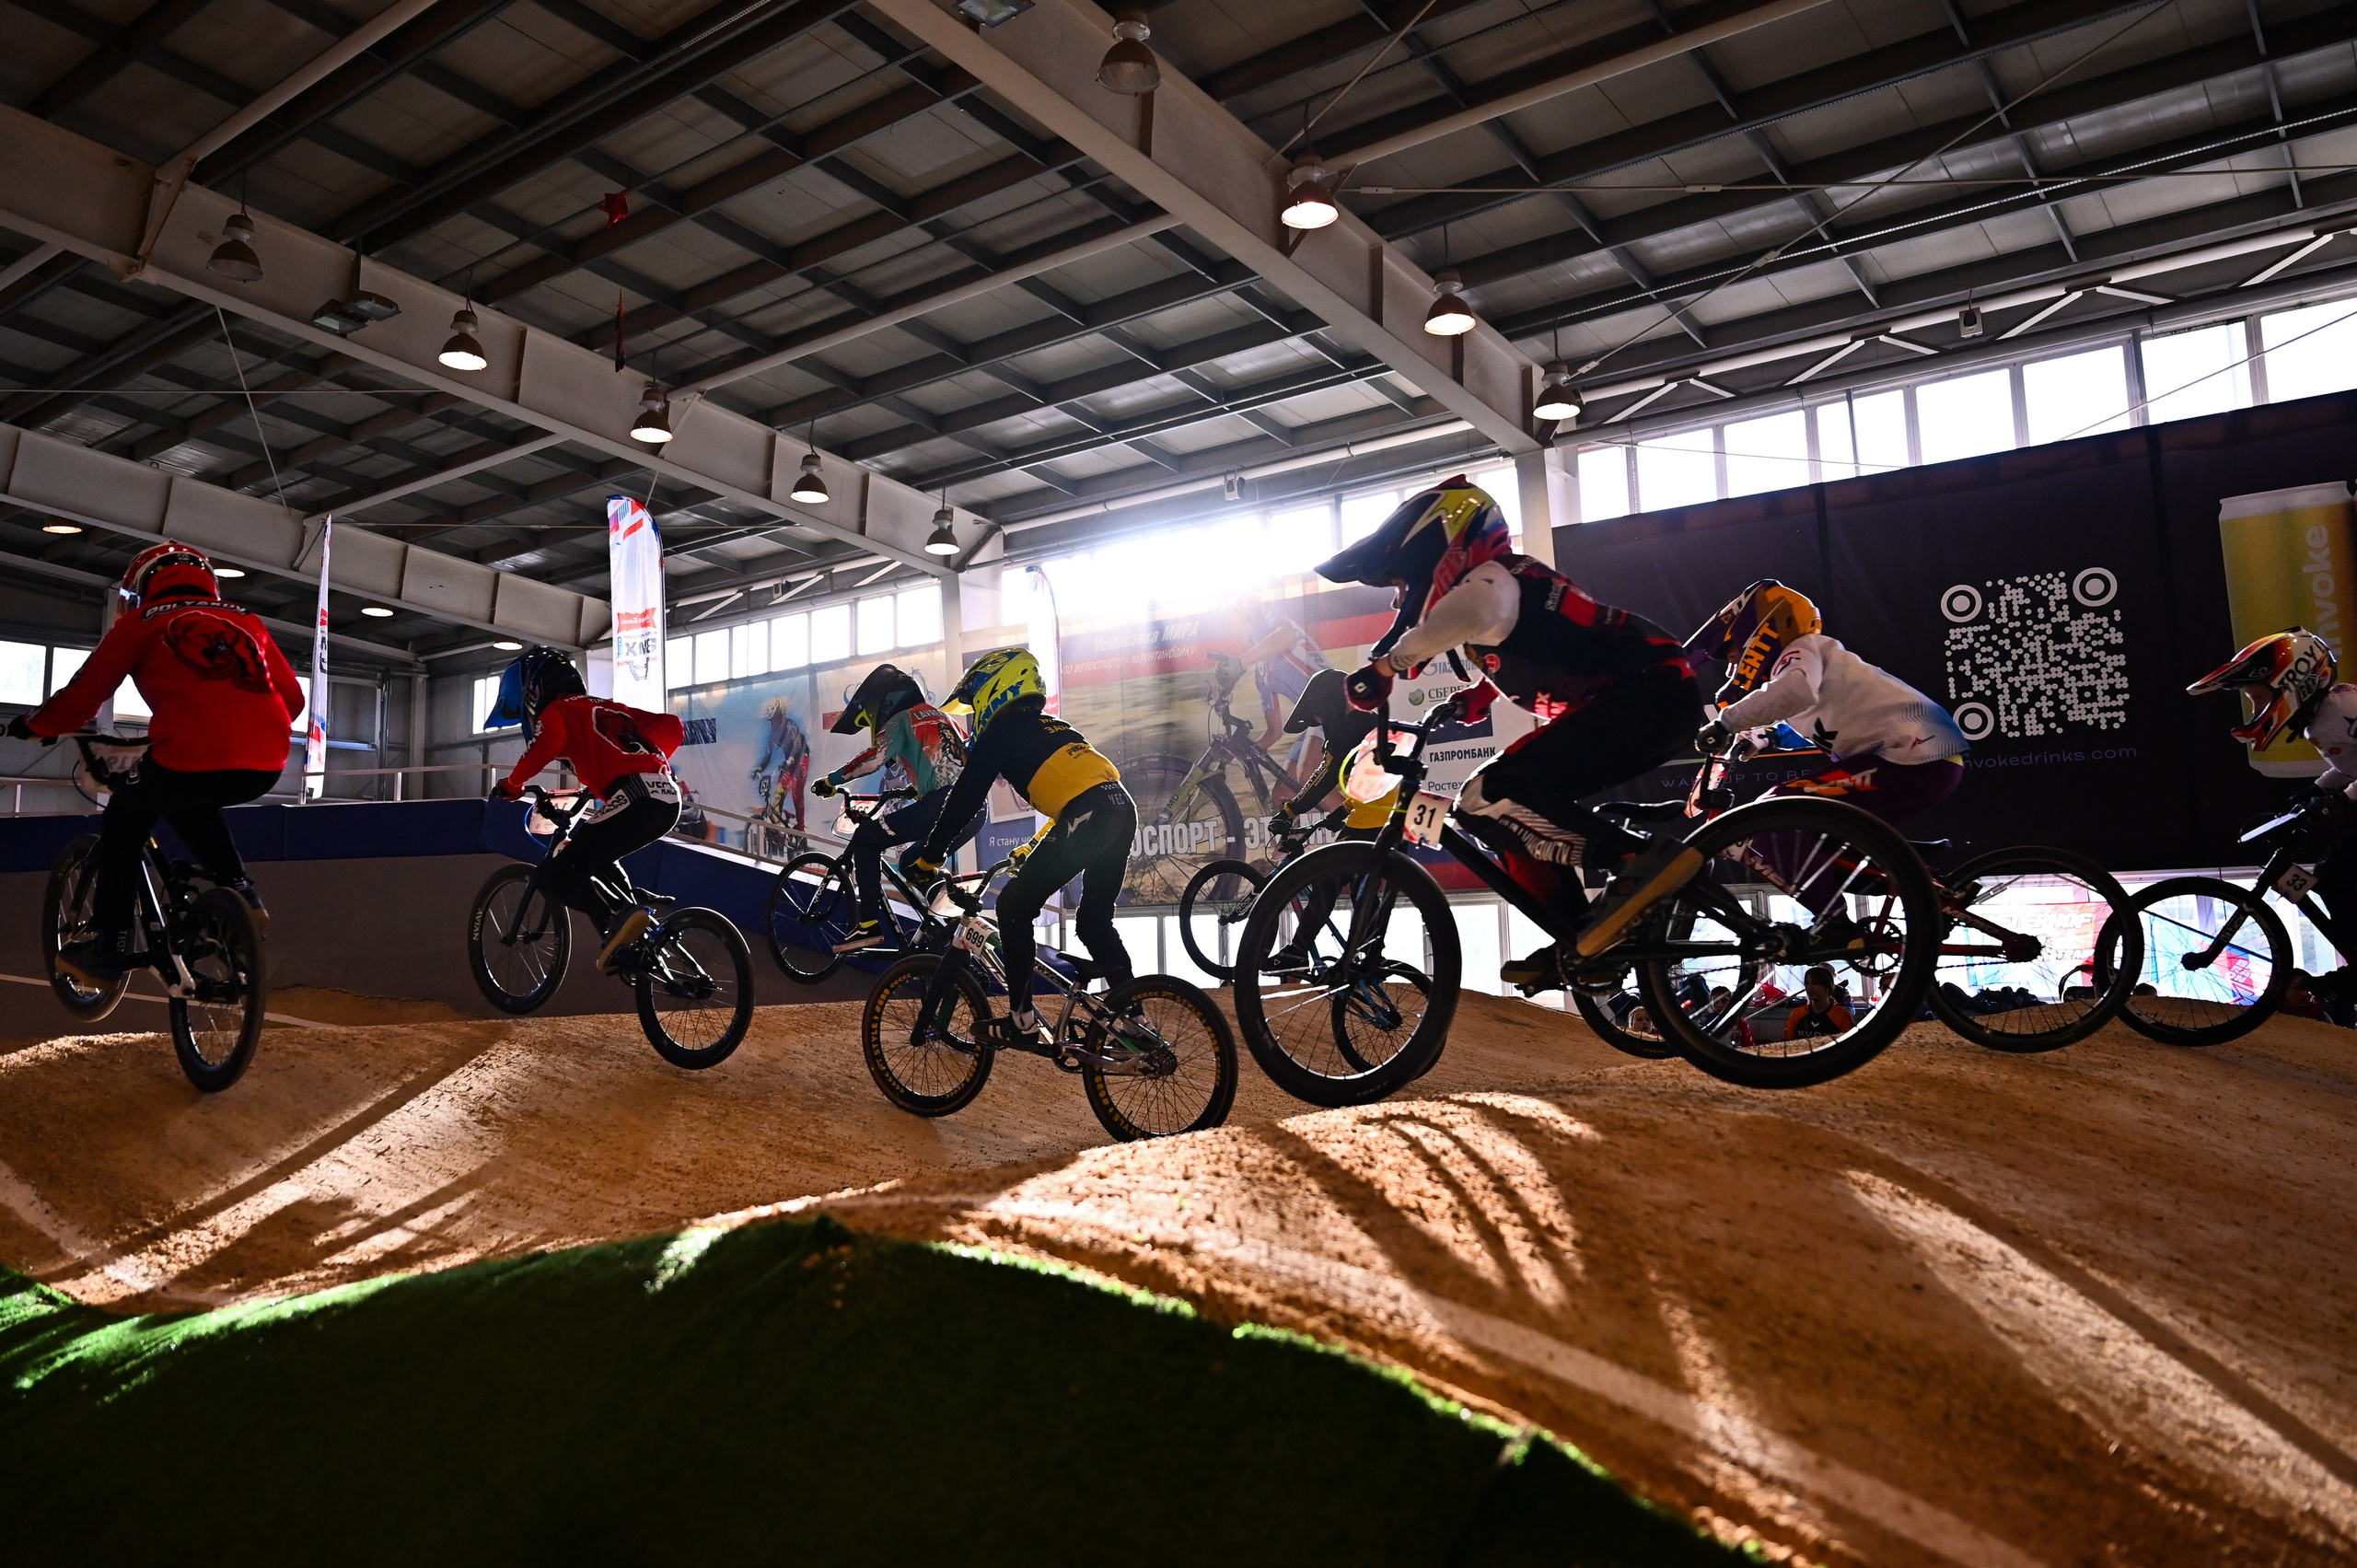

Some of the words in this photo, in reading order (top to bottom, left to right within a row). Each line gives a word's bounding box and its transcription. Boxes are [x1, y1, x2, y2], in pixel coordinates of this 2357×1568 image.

[145, 599, 247, 619] POLYAKOV
[1161, 620, 1201, 642] МИРА
[1132, 645, 1198, 665] маунтинбайку
[1429, 747, 1496, 762] ГАЗПРОМБАНК
[1963, 747, 2137, 769] nvokedrinks.com
[1428, 781, 1463, 792] Ростех
[1753, 772, 1778, 782] TO
[1413, 804, 1437, 829] 31
[989, 836, 995, 846] Я
[996, 836, 1019, 847] стану
[1130, 820, 1217, 857] ОСПОРТ
[1244, 816, 1280, 850] ЭТ
[2286, 874, 2307, 892] 33
[472, 907, 482, 941] AVIAN
[965, 927, 985, 948] 699
[871, 1022, 879, 1056] STYLE
